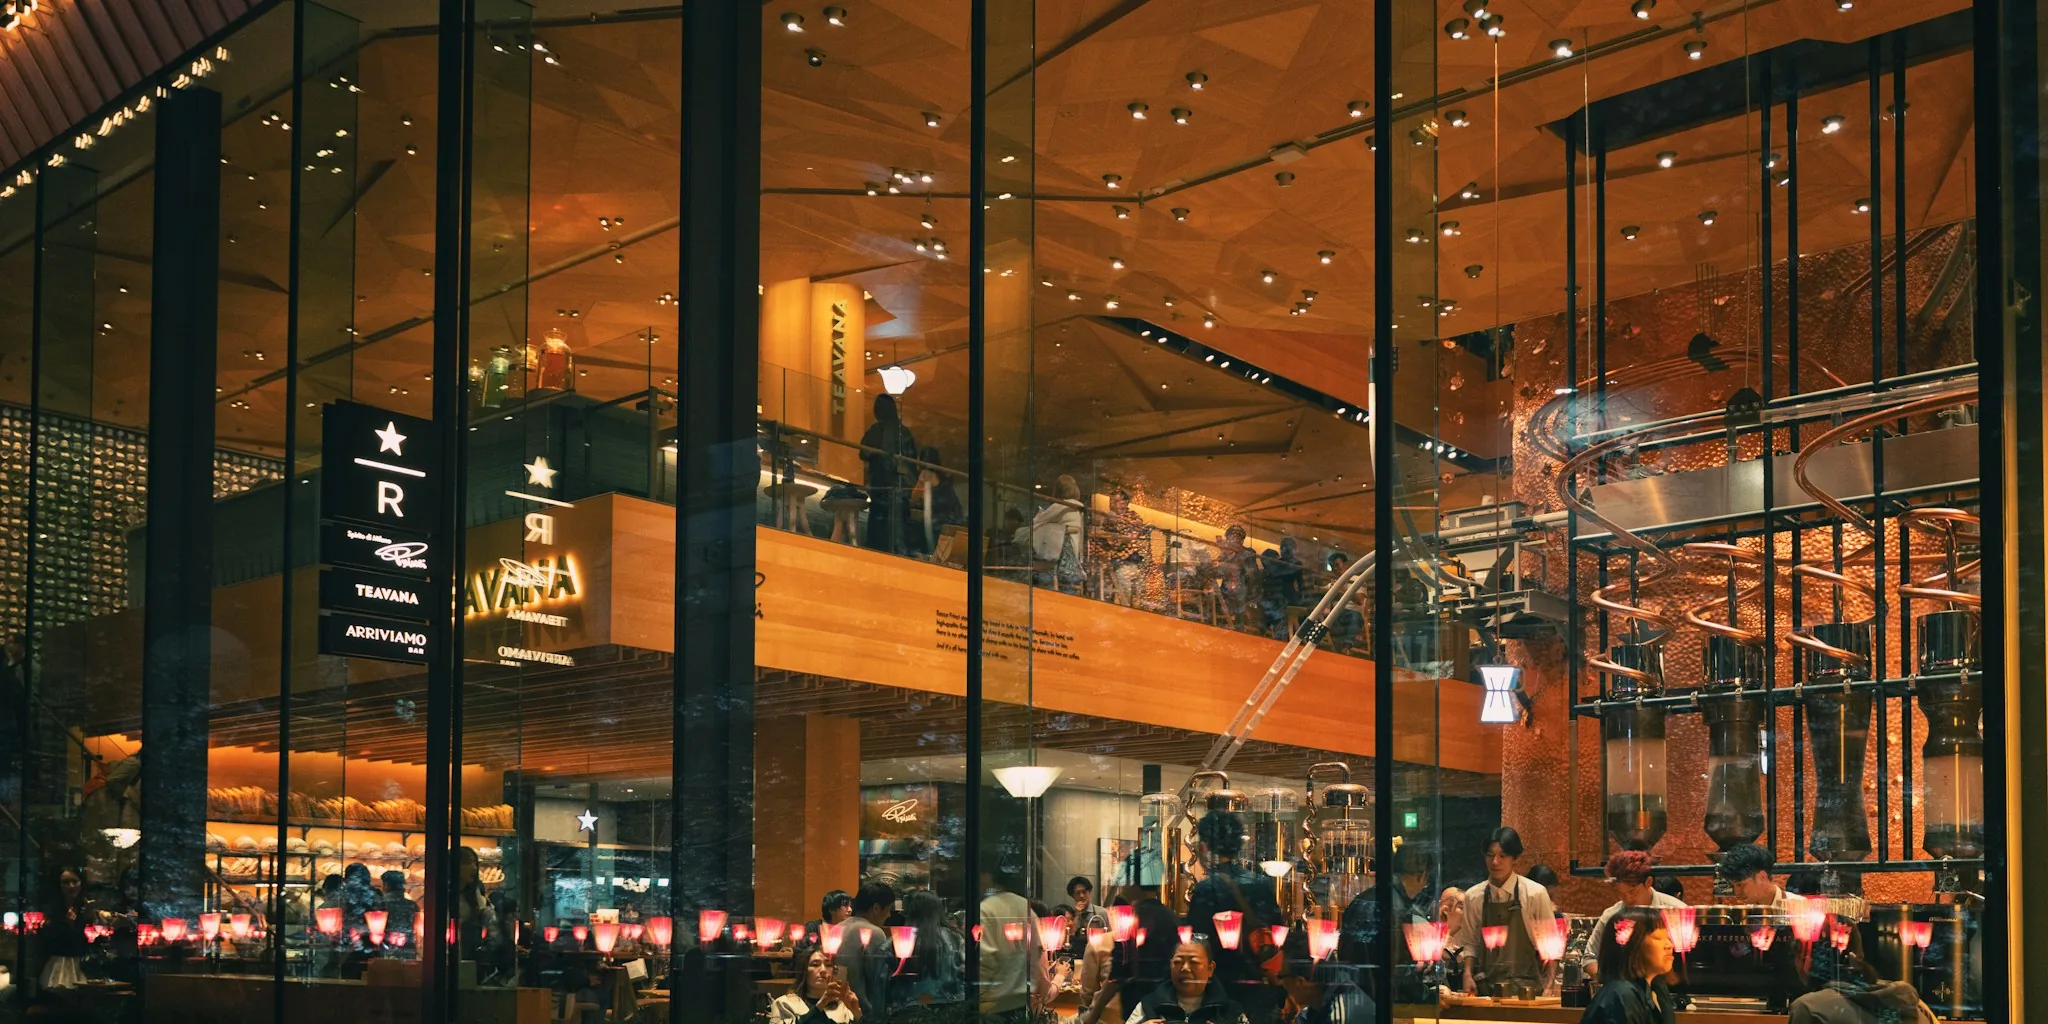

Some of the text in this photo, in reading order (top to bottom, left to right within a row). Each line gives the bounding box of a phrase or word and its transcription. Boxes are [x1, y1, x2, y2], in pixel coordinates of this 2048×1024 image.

[831, 298, 848, 415] TEAVANA
[378, 480, 404, 518] R
[355, 584, 419, 605] TEAVANA
[346, 625, 427, 646] ARRIVIAMO
[408, 647, 424, 655] BAR
